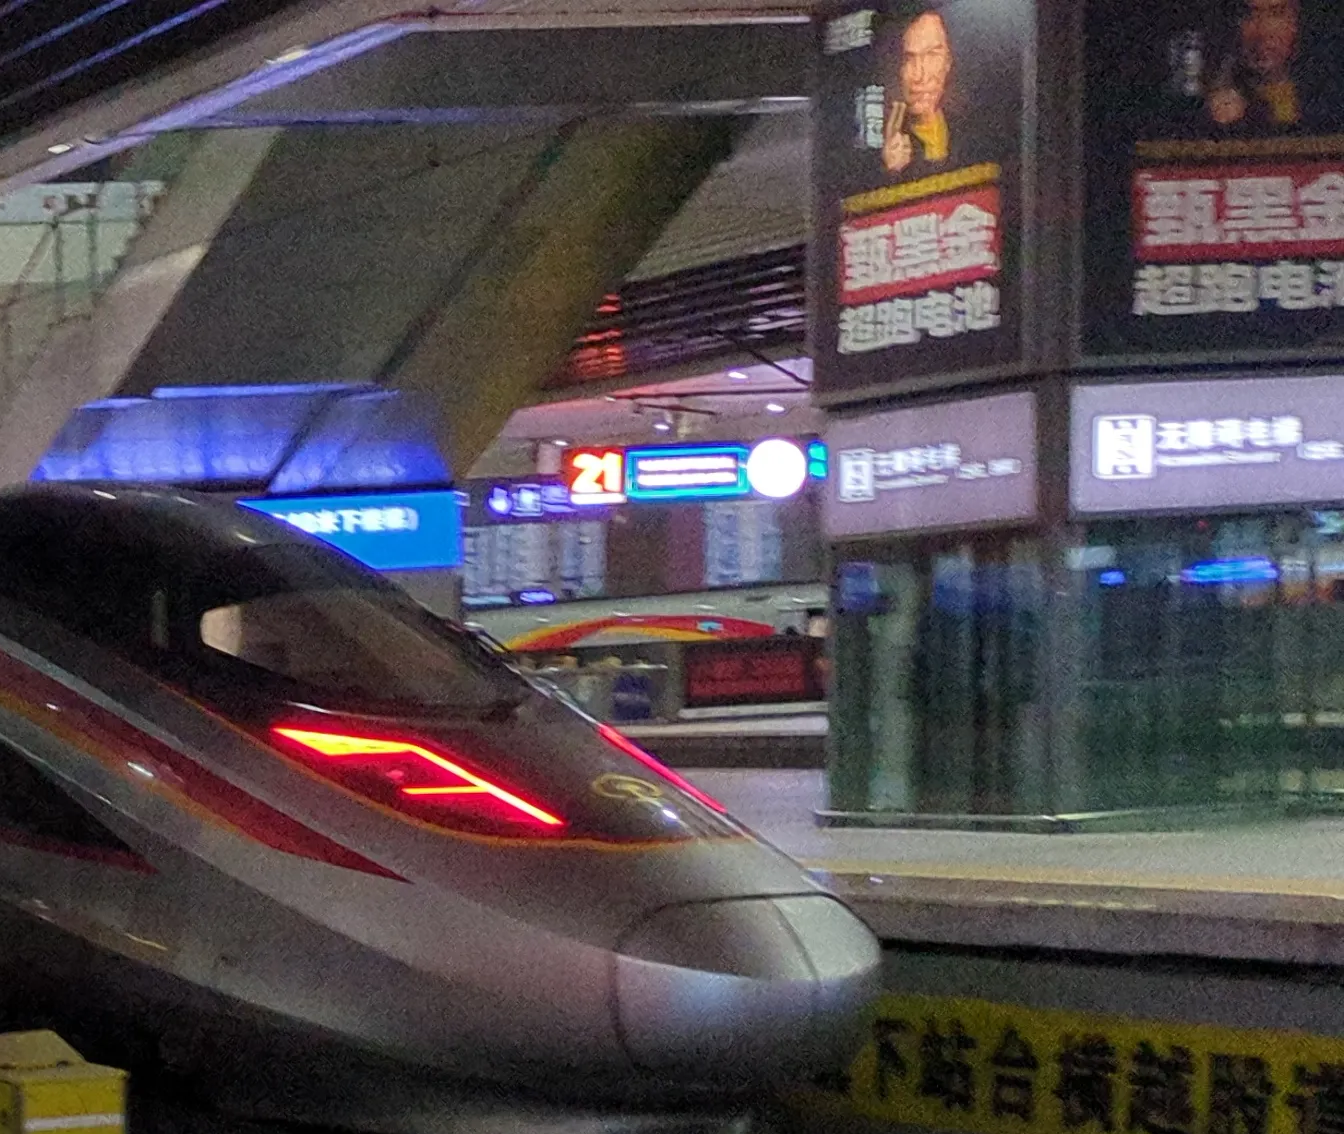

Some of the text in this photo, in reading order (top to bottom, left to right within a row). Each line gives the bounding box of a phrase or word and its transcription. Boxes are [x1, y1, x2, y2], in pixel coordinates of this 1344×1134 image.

[837, 281, 1001, 354] 超跑电池
[571, 452, 622, 492] 21
